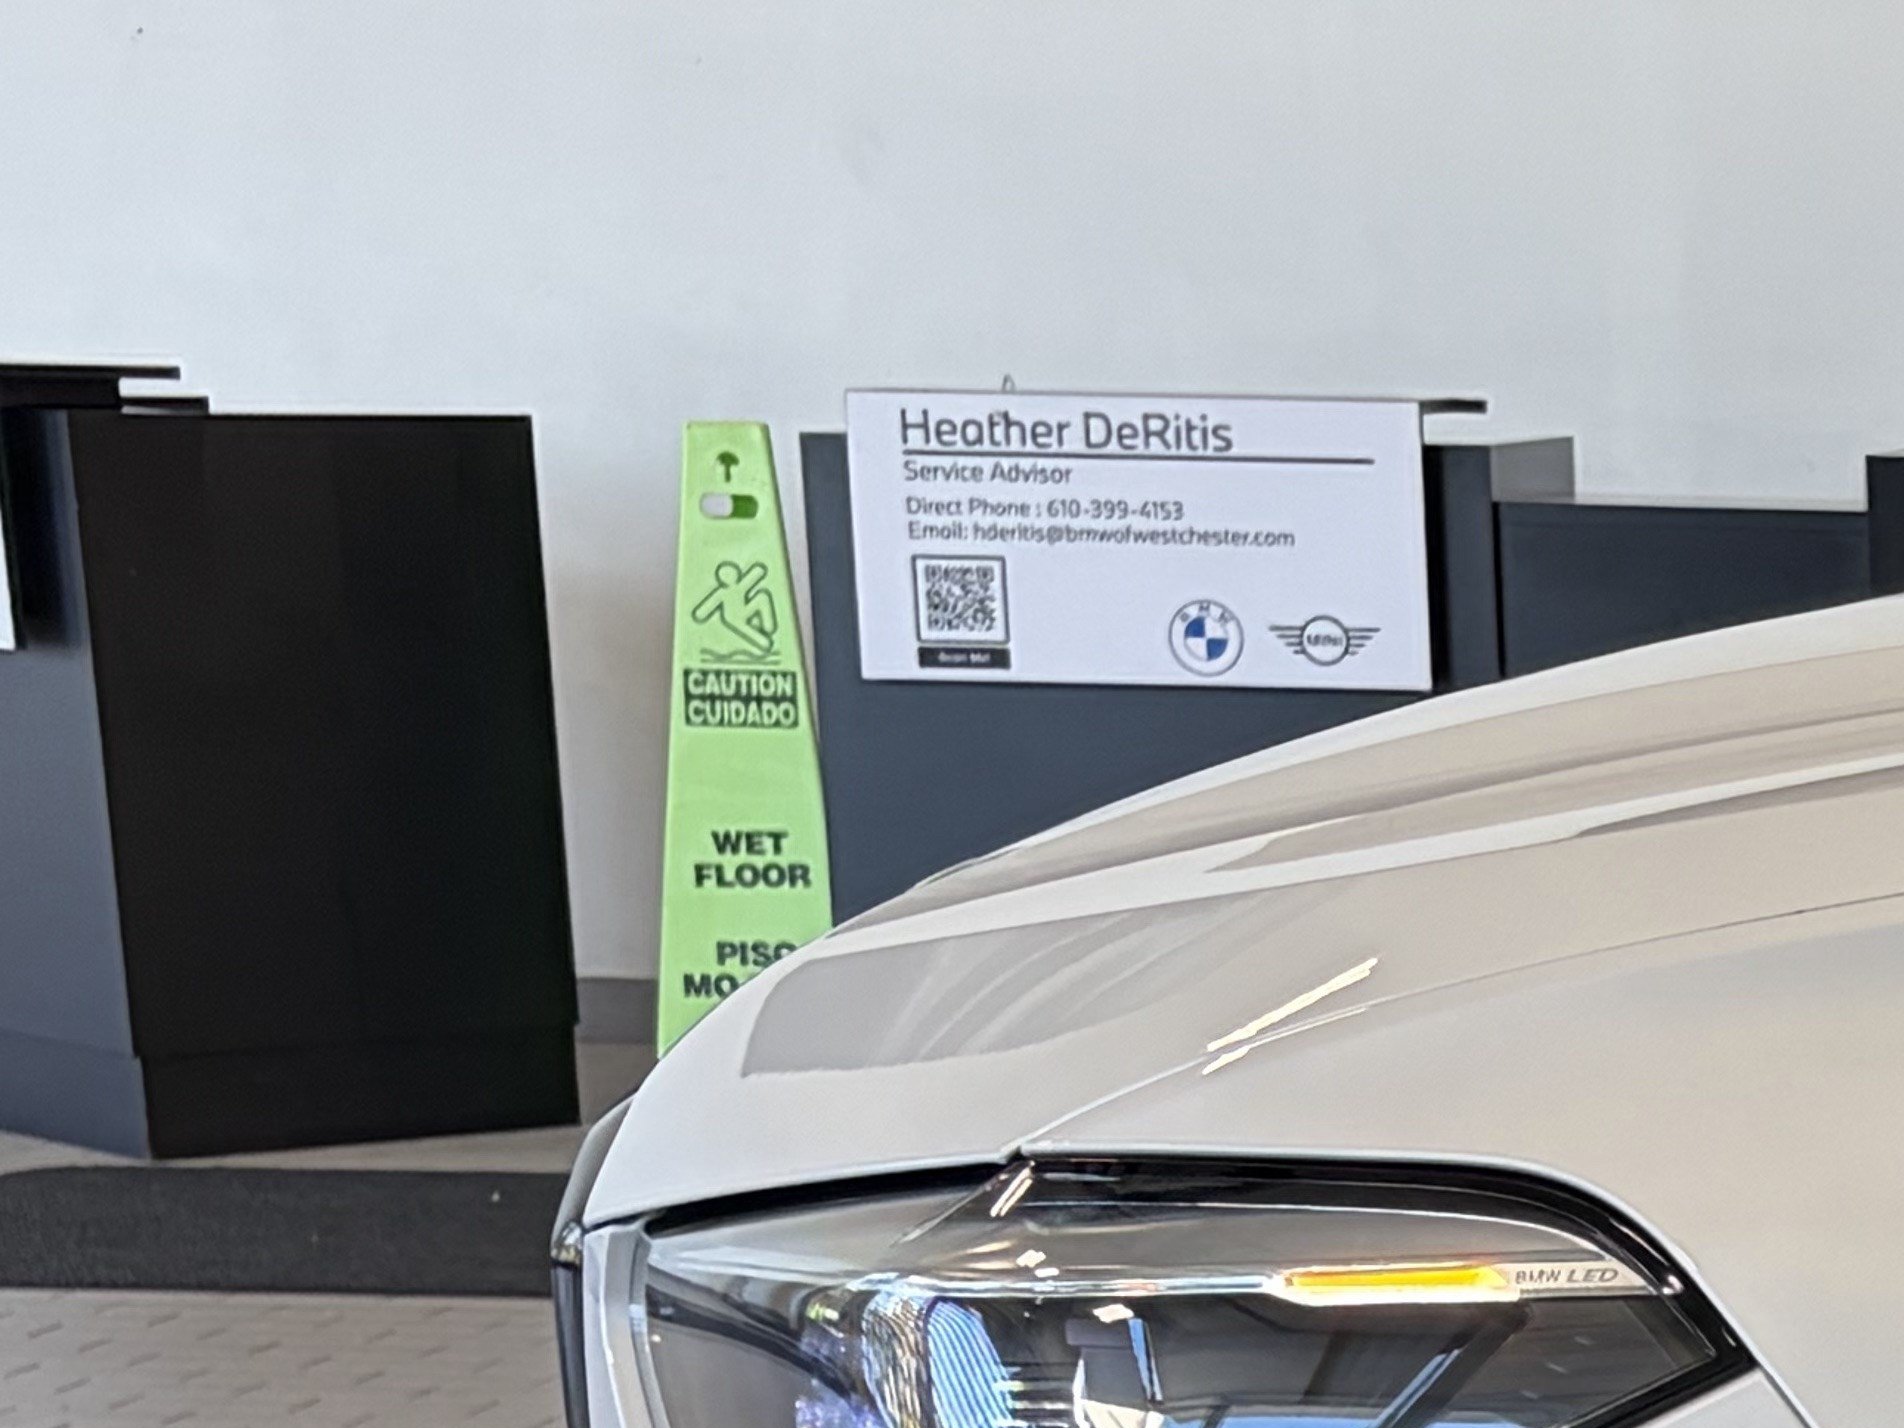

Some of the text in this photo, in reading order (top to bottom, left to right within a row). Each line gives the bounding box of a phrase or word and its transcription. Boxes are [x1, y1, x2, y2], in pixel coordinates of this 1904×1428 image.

[900, 408, 1234, 453] Heather DeRitis
[903, 460, 1073, 484] Service Advisor
[906, 497, 963, 516] Direct
[968, 498, 1030, 517] Phone
[1046, 499, 1185, 520] 610-399-4153
[908, 521, 1296, 547] Email: hderitis@bmwofwestchester.com
[687, 673, 794, 697] CAUTION
[687, 703, 797, 727] CUIDADO
[711, 831, 789, 856] WET
[694, 863, 812, 888] FLOOR
[1515, 1266, 1619, 1285] BMW LED
